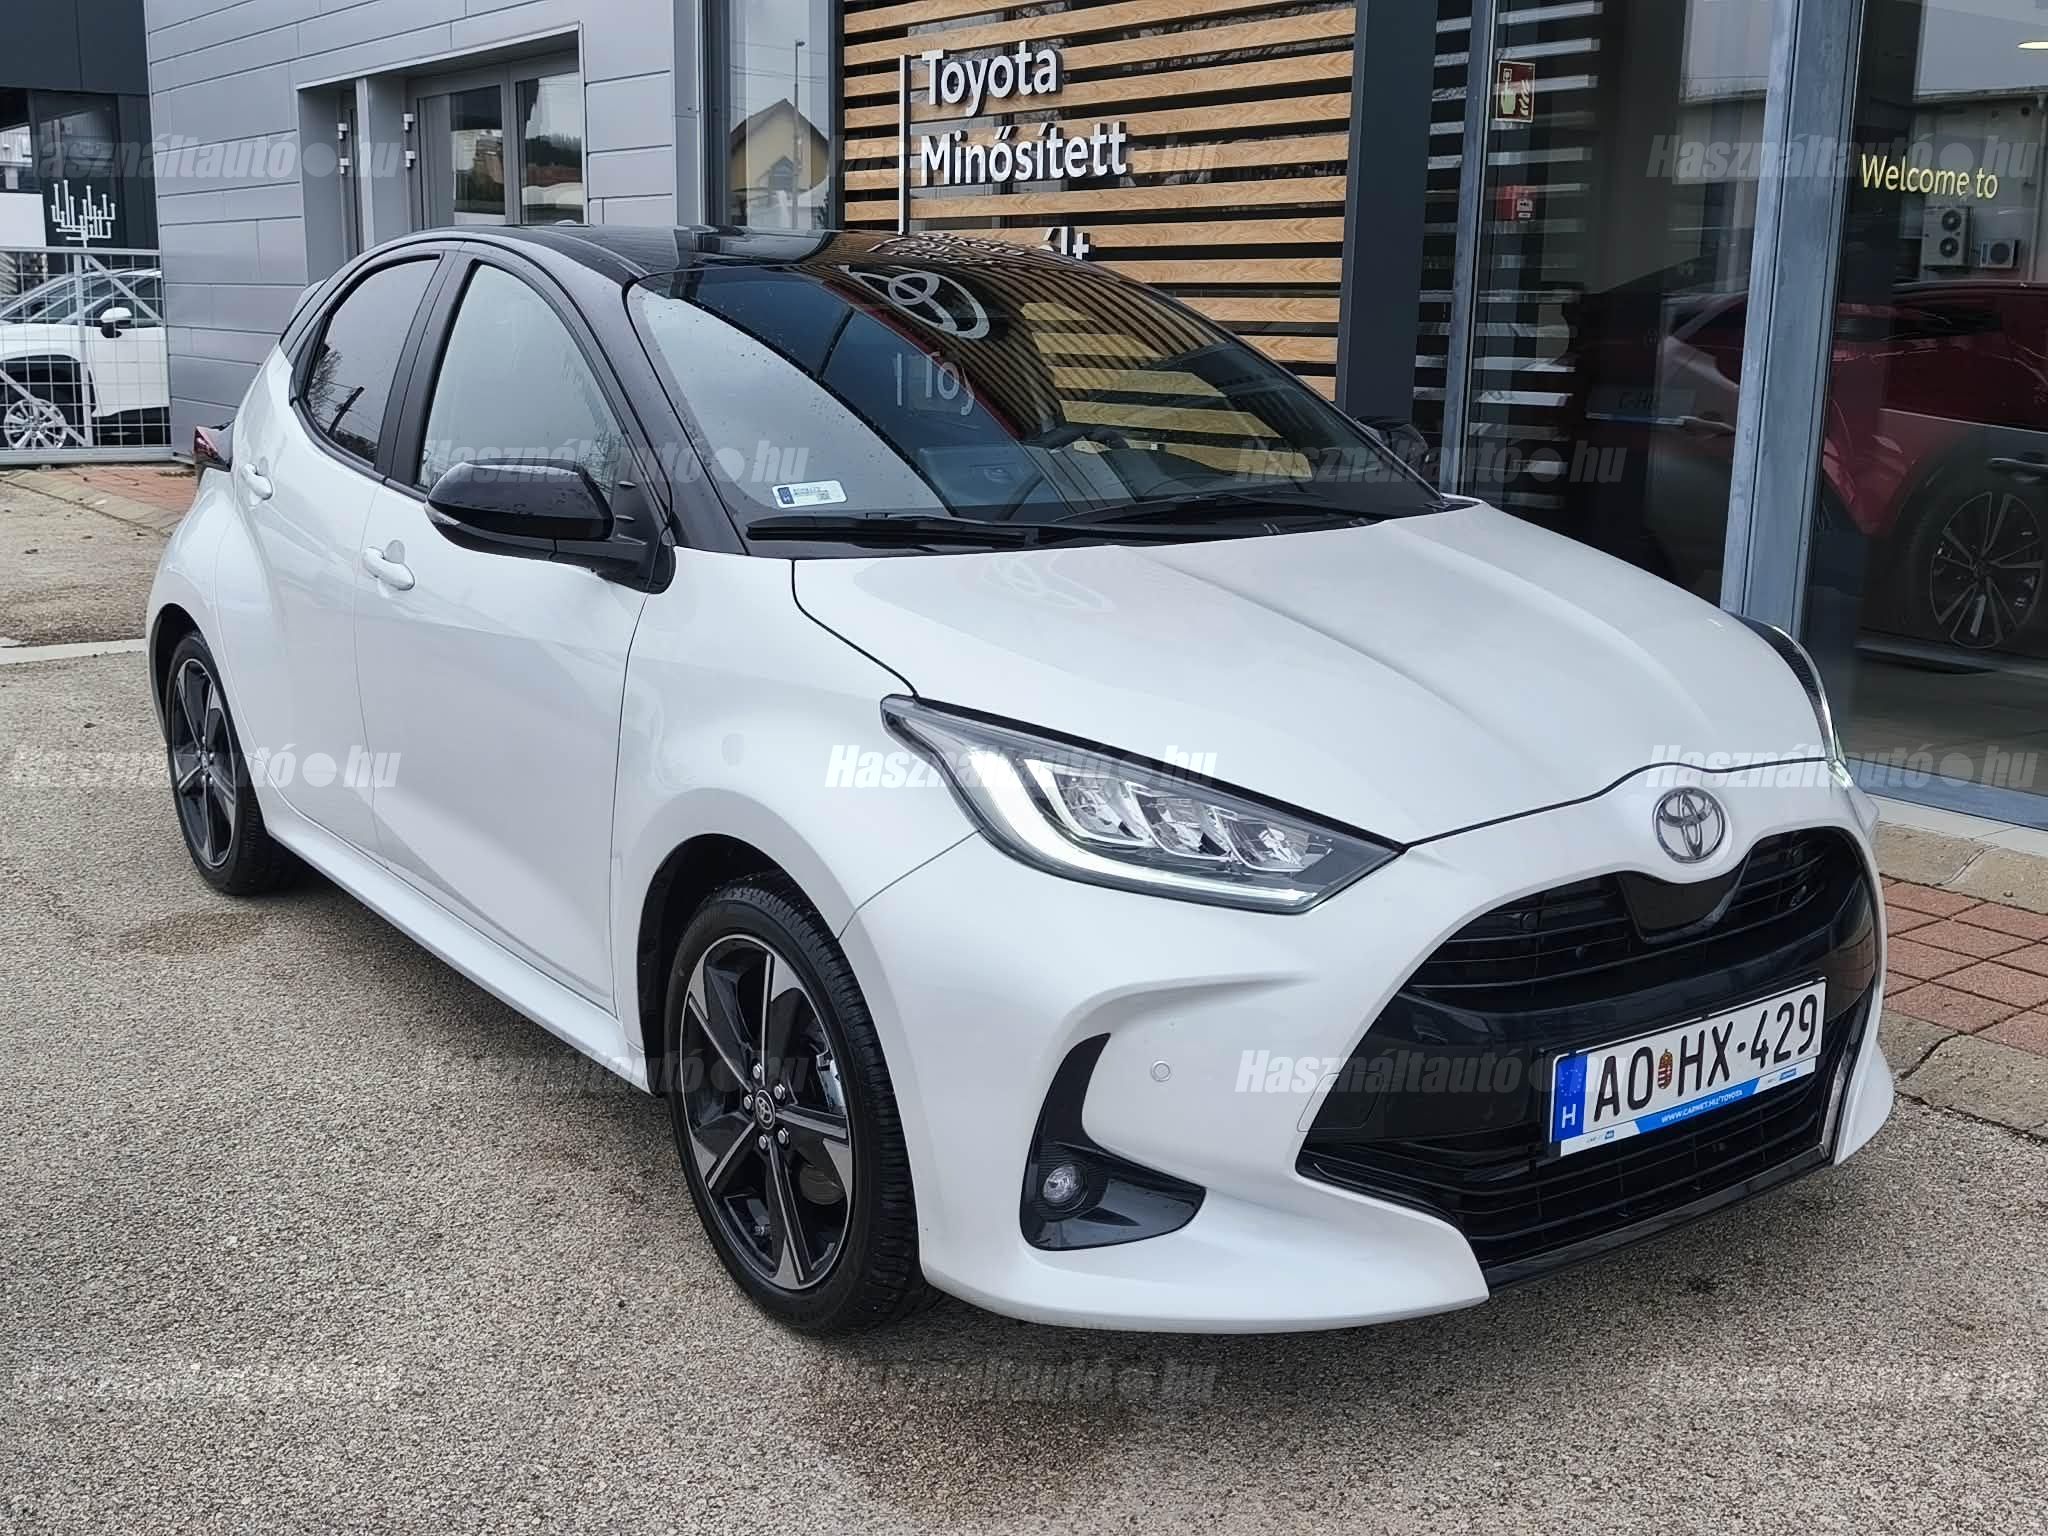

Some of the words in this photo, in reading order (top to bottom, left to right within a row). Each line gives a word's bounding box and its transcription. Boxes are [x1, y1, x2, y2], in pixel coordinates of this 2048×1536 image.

[921, 41, 1060, 117] Toyota
[920, 120, 1129, 187] Minősített
[1860, 152, 1971, 199] Welcome
[1975, 166, 2000, 200] to
[1593, 1046, 1655, 1123] AO
[1677, 994, 1818, 1097] HX-429
[1561, 1103, 1577, 1129] H
